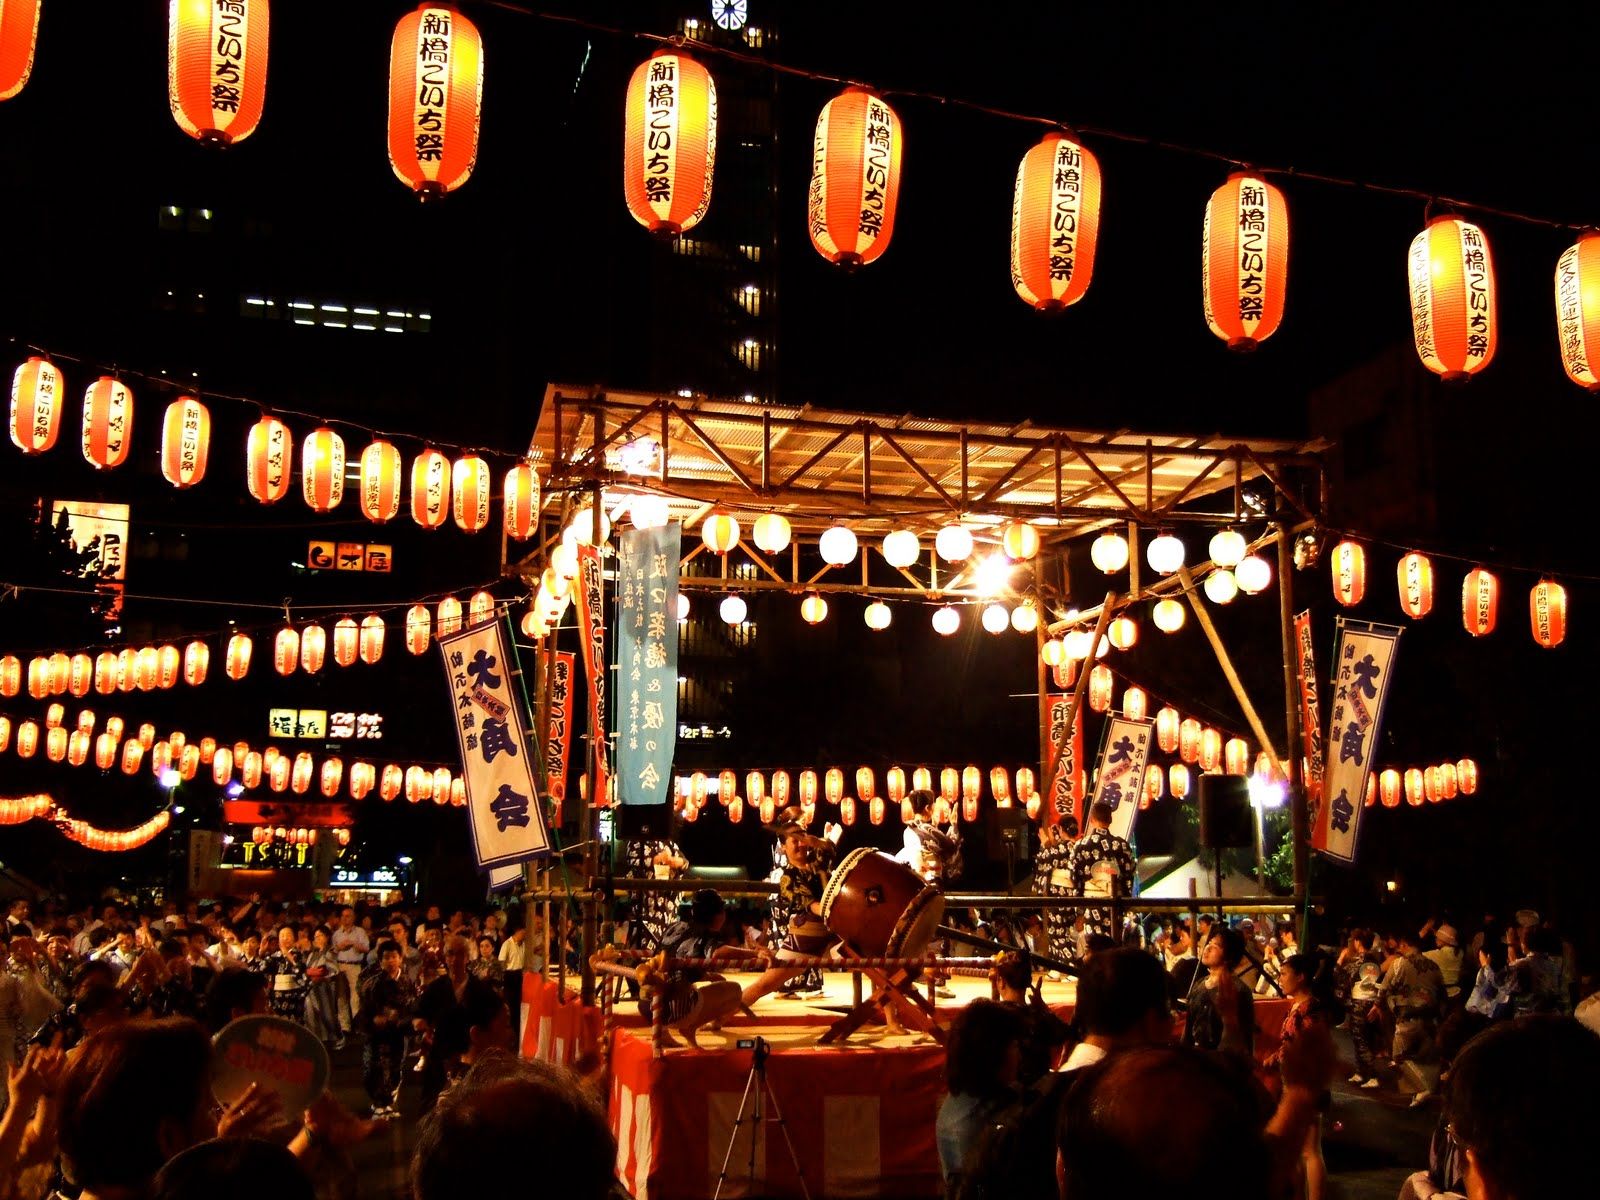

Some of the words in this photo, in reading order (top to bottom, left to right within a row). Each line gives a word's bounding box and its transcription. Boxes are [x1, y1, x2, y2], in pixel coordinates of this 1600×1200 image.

[416, 13, 450, 161] 新橋こいち祭
[645, 62, 673, 202] 新橋こいち祭
[859, 103, 890, 238] 新橋こいち祭
[1050, 146, 1081, 281] 新橋こいち祭
[1239, 186, 1264, 321] 新橋こいち祭
[1462, 228, 1487, 357] 新橋こいち祭
[34, 371, 54, 438] 新橋こいち祭
[181, 409, 198, 471] 新橋こいち祭
